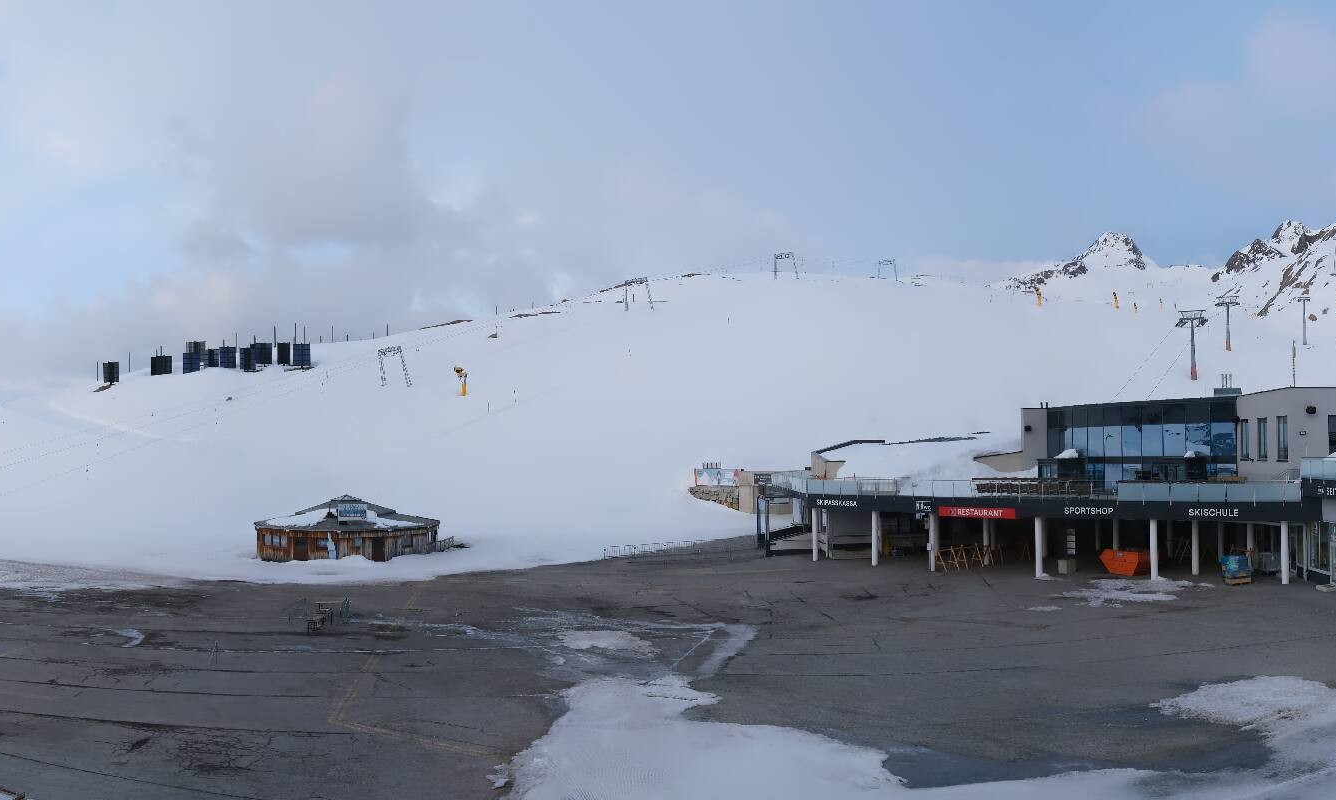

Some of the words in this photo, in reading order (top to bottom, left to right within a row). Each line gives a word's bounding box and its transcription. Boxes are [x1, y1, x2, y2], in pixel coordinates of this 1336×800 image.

[957, 508, 1003, 517] RESTAURANT
[1064, 506, 1114, 515] SPORTSHOP
[1188, 508, 1239, 517] SKISCHULE
